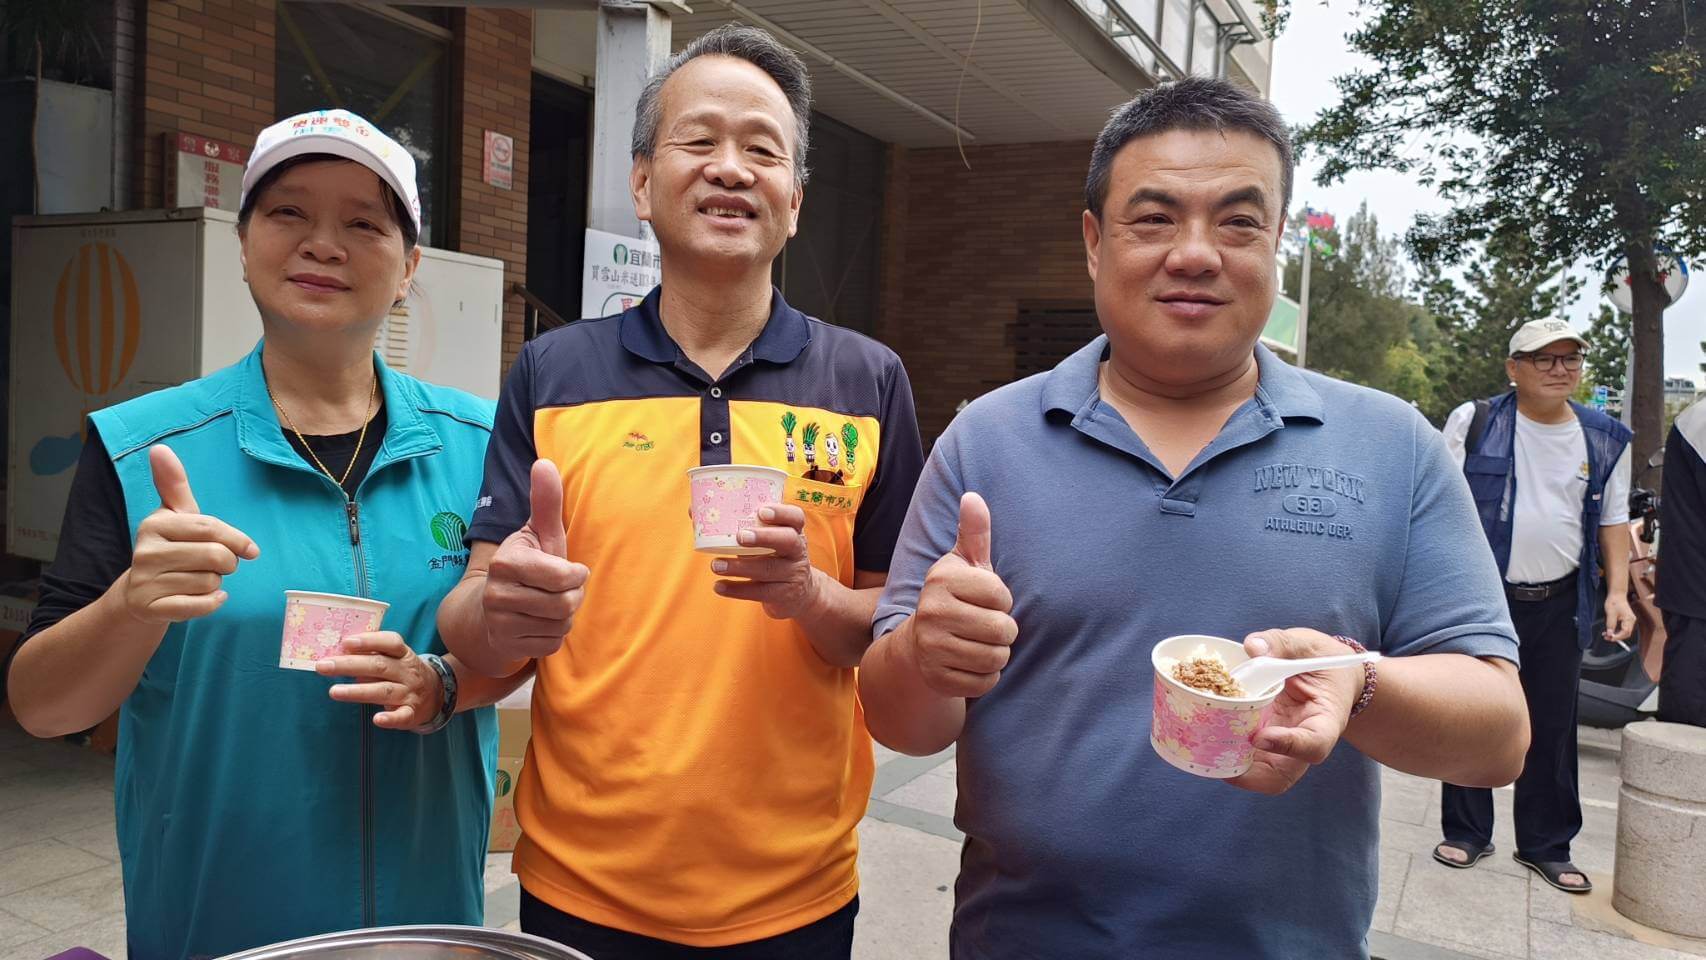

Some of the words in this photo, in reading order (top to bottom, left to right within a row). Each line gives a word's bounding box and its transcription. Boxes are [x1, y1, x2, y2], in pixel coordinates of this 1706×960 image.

[1254, 464, 1301, 493] NEW
[1307, 465, 1365, 505] YORK
[1297, 497, 1322, 513] 93
[1265, 516, 1325, 536] ATHLETIC
[1327, 522, 1353, 540] DEP.
